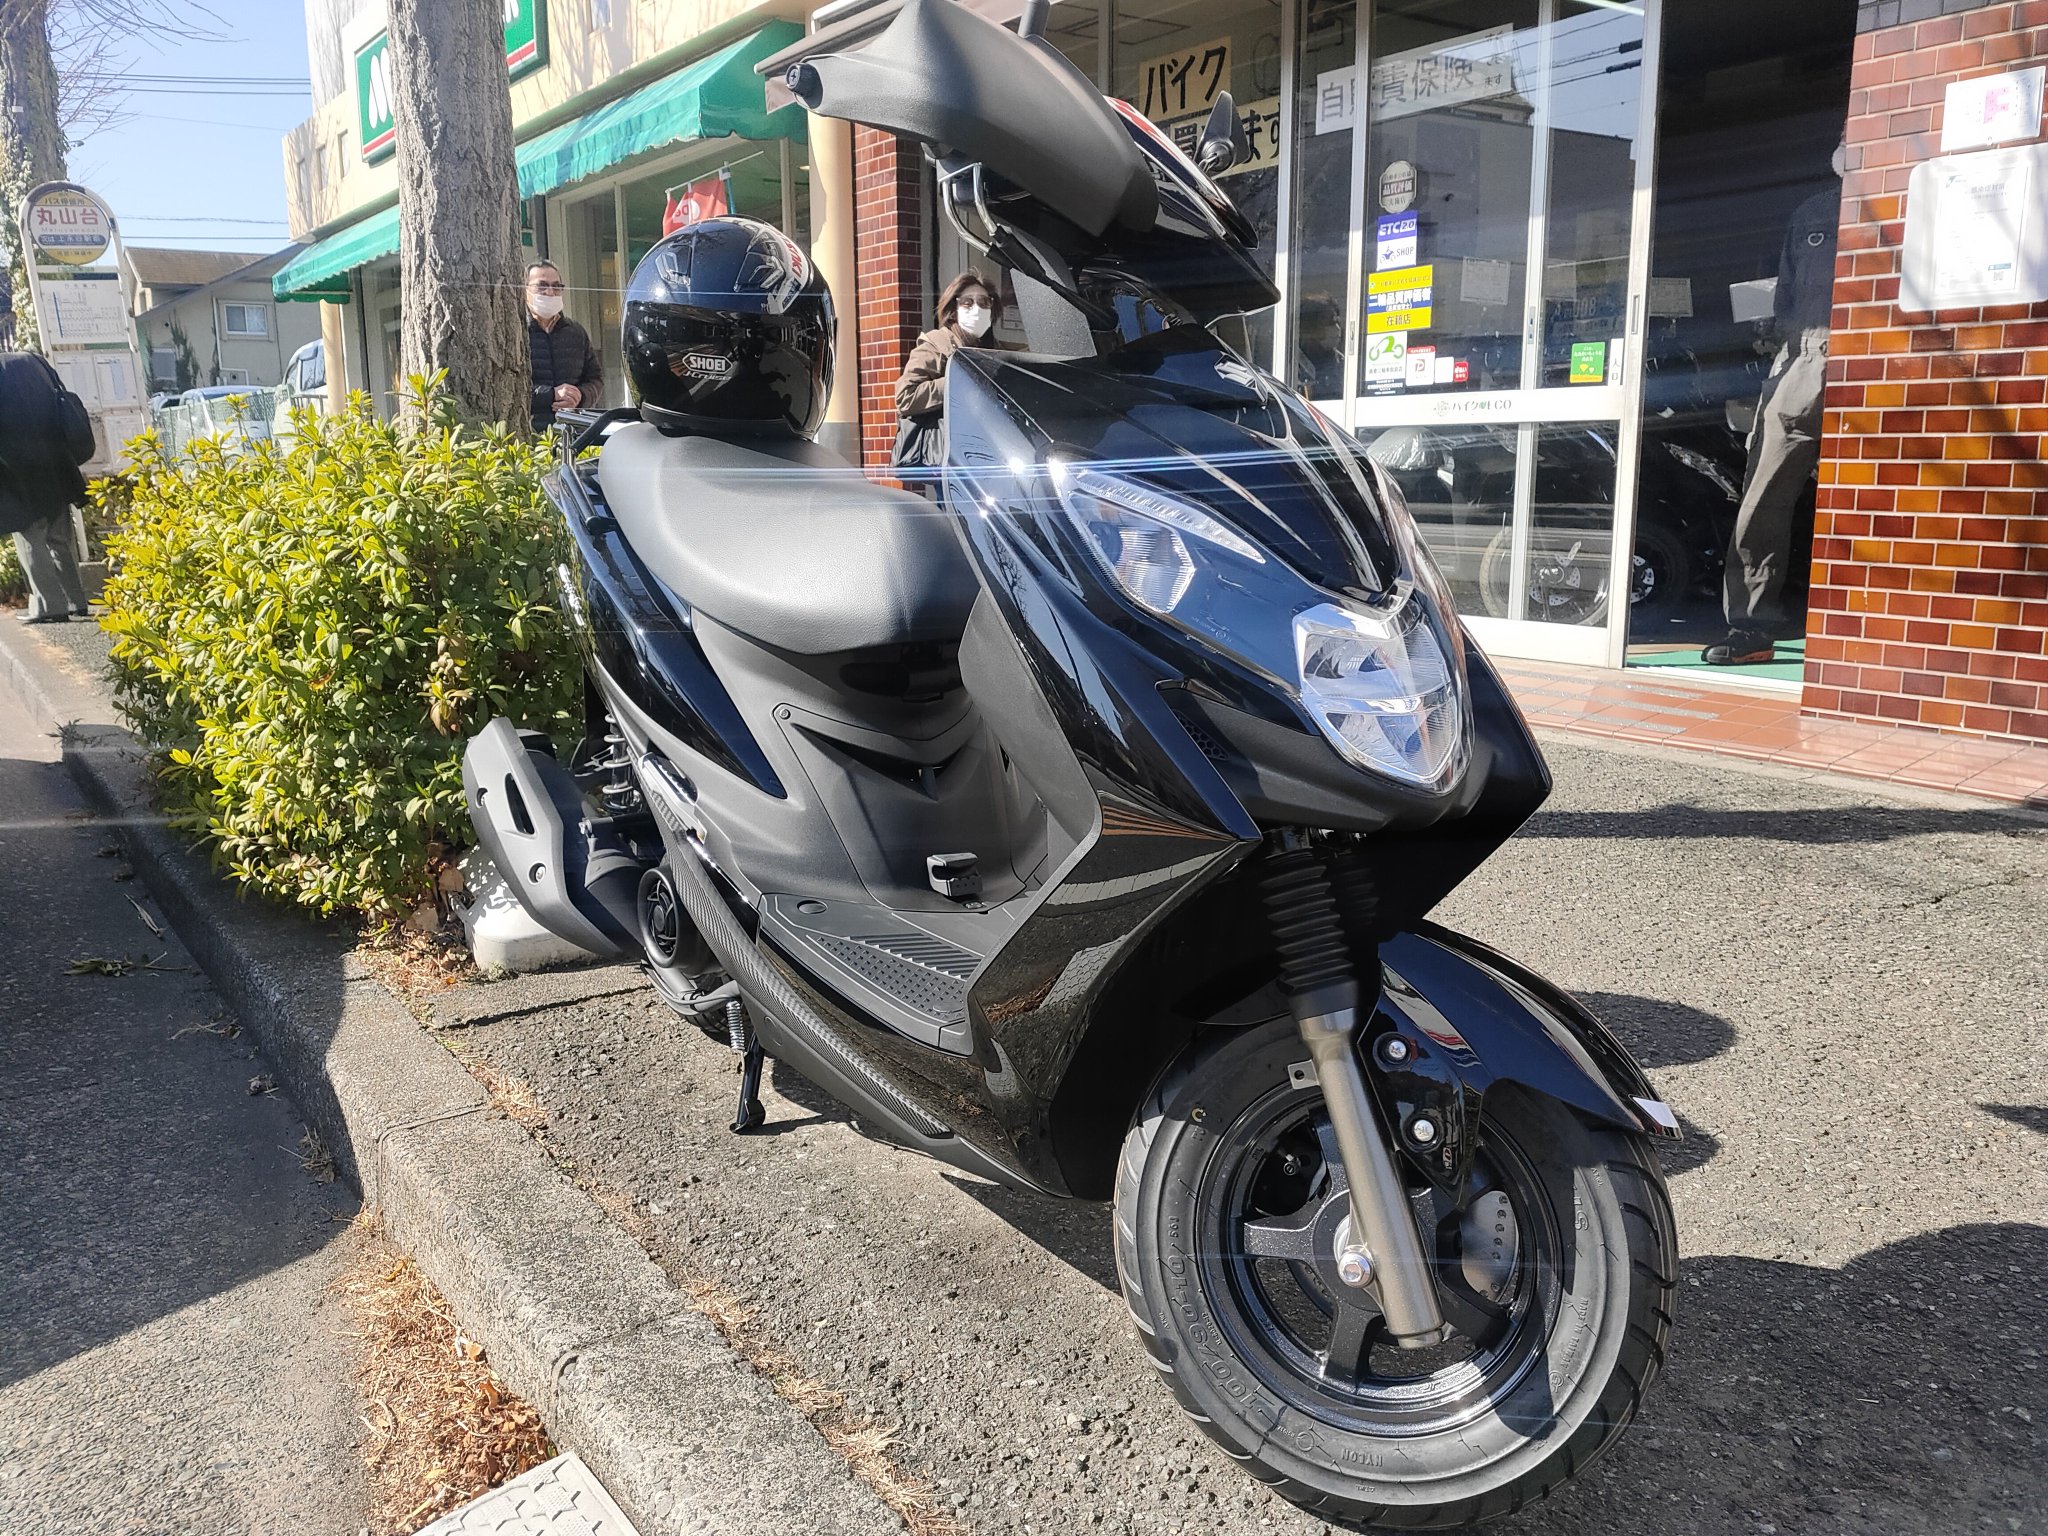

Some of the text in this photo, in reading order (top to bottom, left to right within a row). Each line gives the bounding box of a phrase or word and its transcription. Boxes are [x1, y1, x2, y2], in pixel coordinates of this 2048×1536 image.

[1144, 46, 1227, 118] バイク
[1174, 103, 1280, 165] 買ます
[36, 207, 99, 225] 丸山台
[1396, 246, 1415, 257] SHOP
[1386, 313, 1411, 327] 在籍店
[689, 356, 726, 372] SHOEI
[1611, 358, 1621, 381] 入口
[1167, 1254, 1255, 1409] 100/90-10
[1340, 1449, 1383, 1467] NYLON
